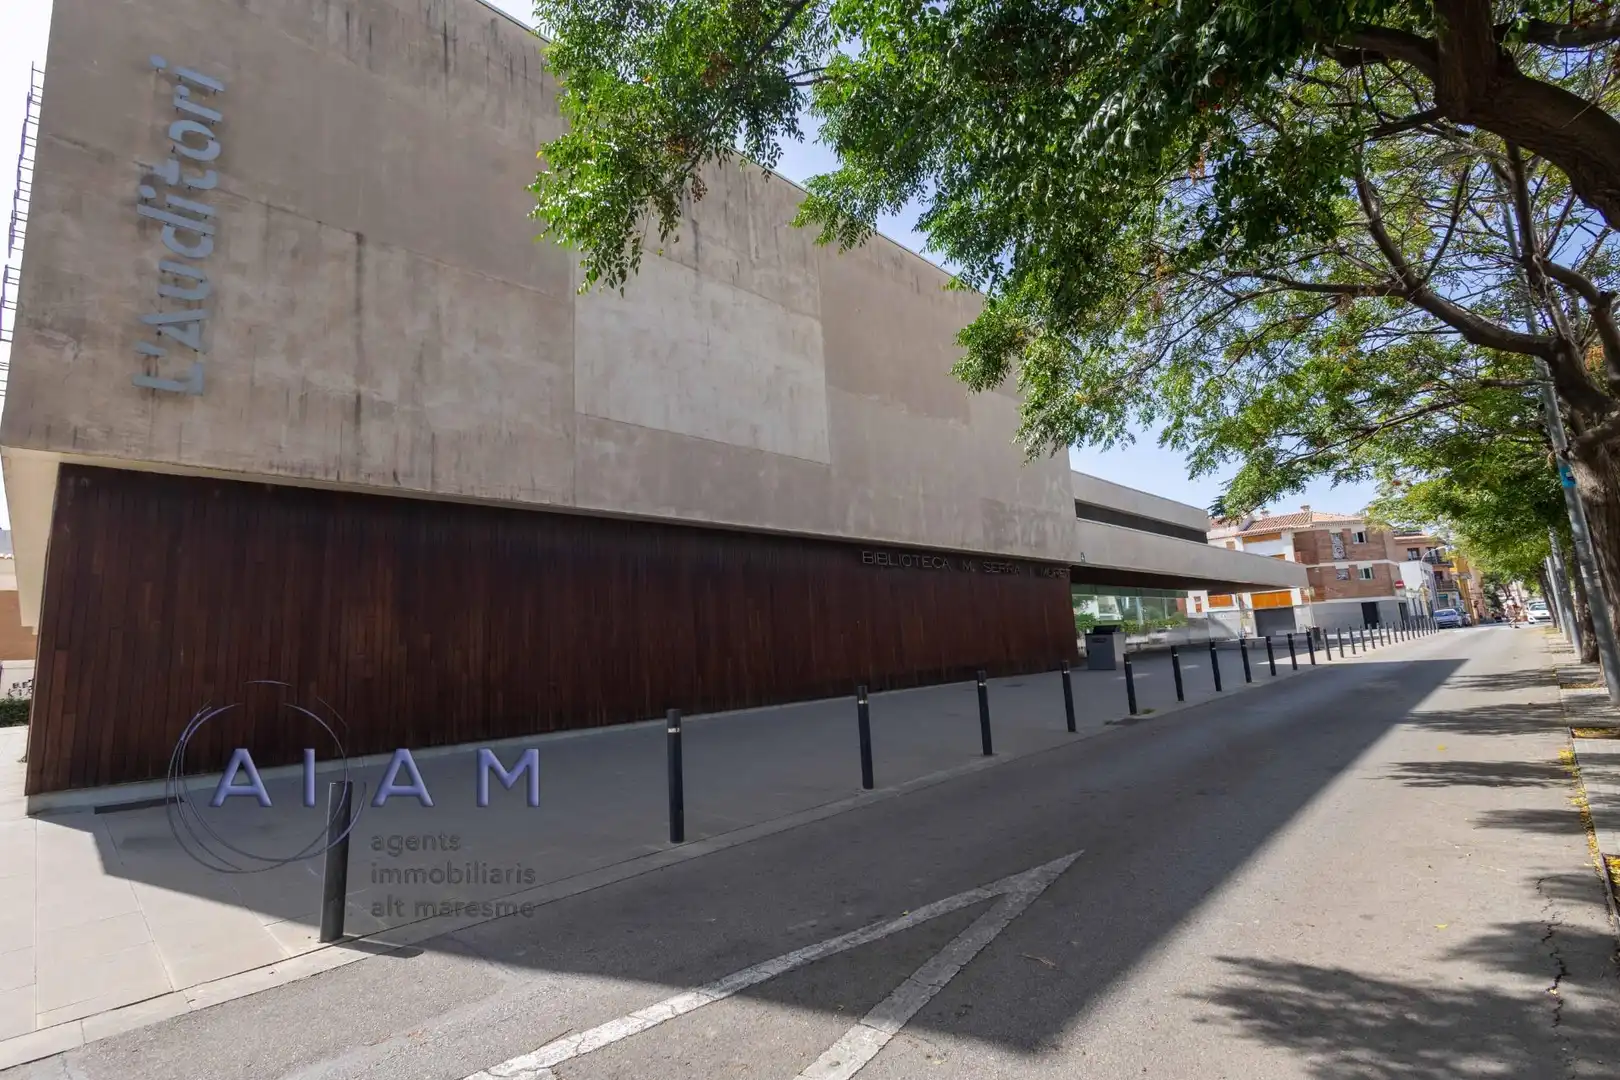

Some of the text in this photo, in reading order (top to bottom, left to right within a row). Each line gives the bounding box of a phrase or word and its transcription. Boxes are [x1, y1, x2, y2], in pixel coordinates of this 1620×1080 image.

[133, 55, 225, 395] L'Auditori
[861, 551, 951, 571] BIBLIOTECA
[983, 561, 1020, 577] SERRA
